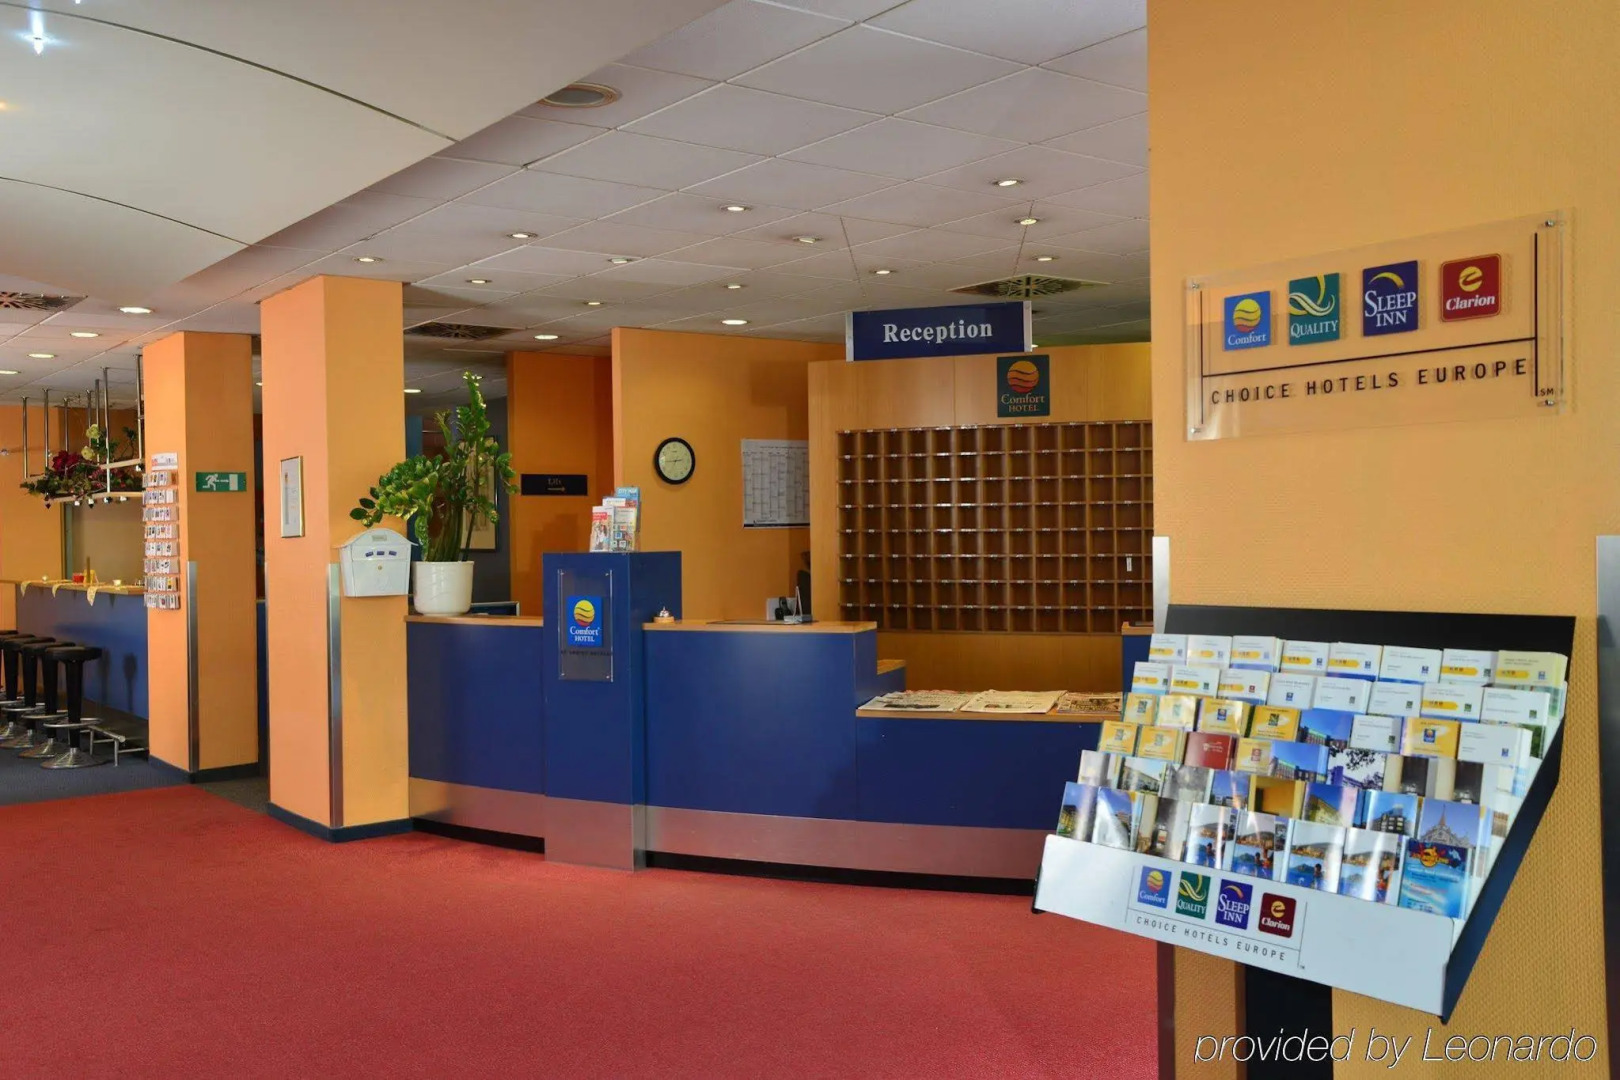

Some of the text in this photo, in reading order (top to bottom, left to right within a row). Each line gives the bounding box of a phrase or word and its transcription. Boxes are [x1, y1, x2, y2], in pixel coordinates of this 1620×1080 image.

[1364, 290, 1416, 317] SLEEP
[1446, 295, 1495, 310] Clarion
[1376, 310, 1407, 327] INN
[883, 320, 993, 344] Reception
[1290, 320, 1338, 338] QUALITY
[1227, 332, 1266, 346] Comfort
[1211, 358, 1527, 404] CHOICE HOTELS EUROPE
[1001, 392, 1045, 405] Comfort
[570, 626, 598, 635] Comfort
[1139, 890, 1166, 904] Comfort
[1218, 894, 1250, 915] SLEEP
[1177, 899, 1207, 915] QUALITY
[1223, 911, 1243, 923] INN
[1261, 917, 1290, 931] Clarion
[1136, 916, 1286, 961] CHOICE HOTELS EUROPE
